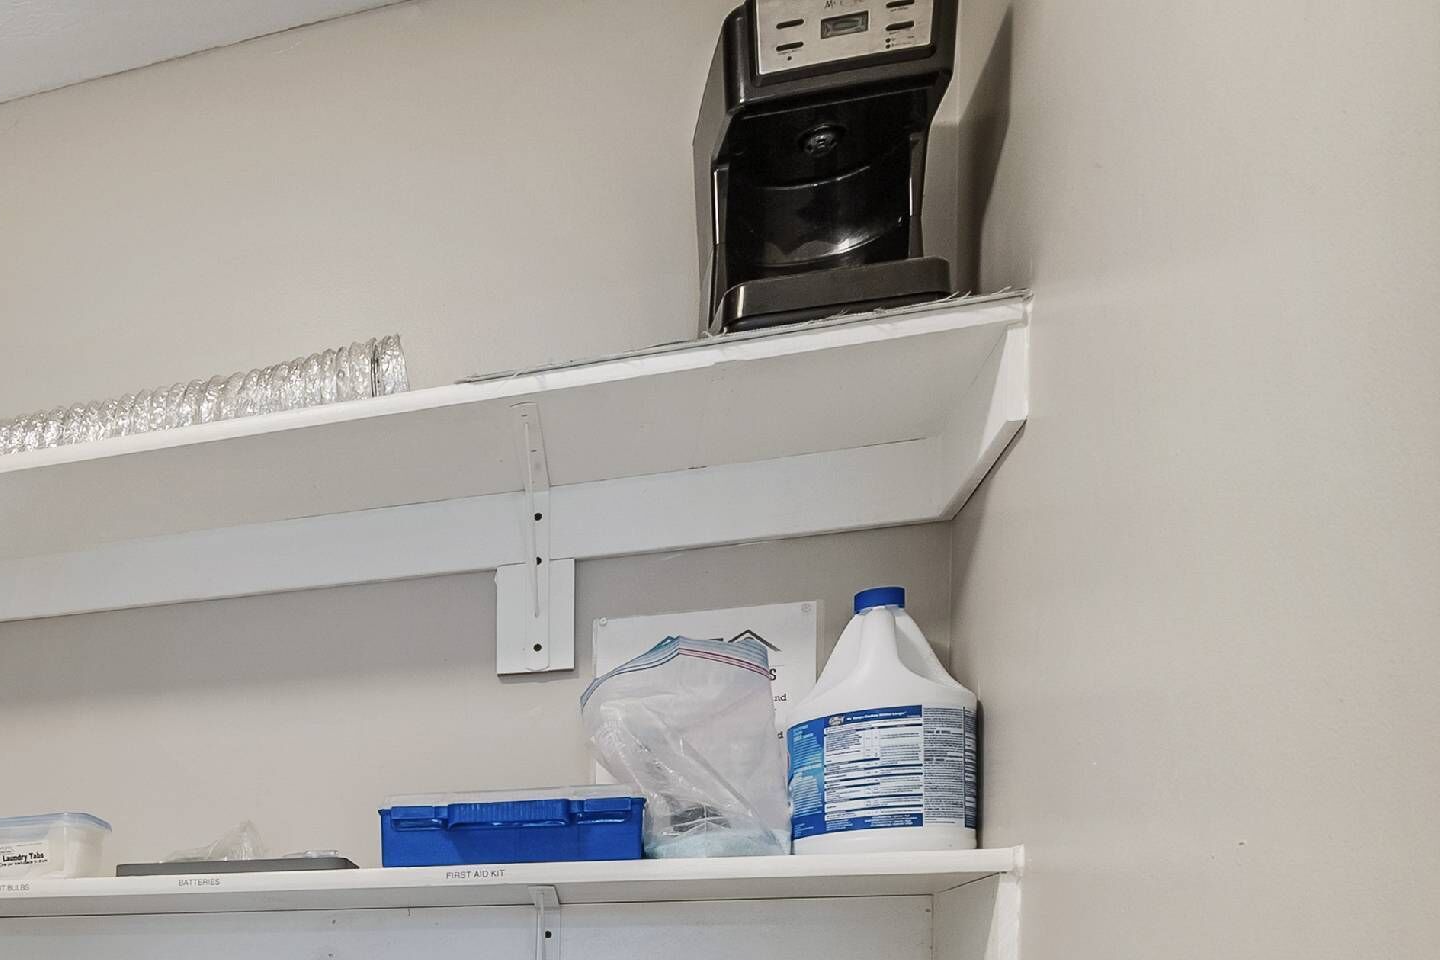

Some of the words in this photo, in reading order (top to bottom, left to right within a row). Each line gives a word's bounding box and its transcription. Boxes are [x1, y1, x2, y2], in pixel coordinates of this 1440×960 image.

[2, 853, 28, 862] Laundry
[28, 851, 45, 859] Tabs
[446, 870, 471, 879] FIRST
[474, 870, 489, 878] AID
[490, 869, 505, 877] KIT
[178, 878, 221, 887] BATTERIES
